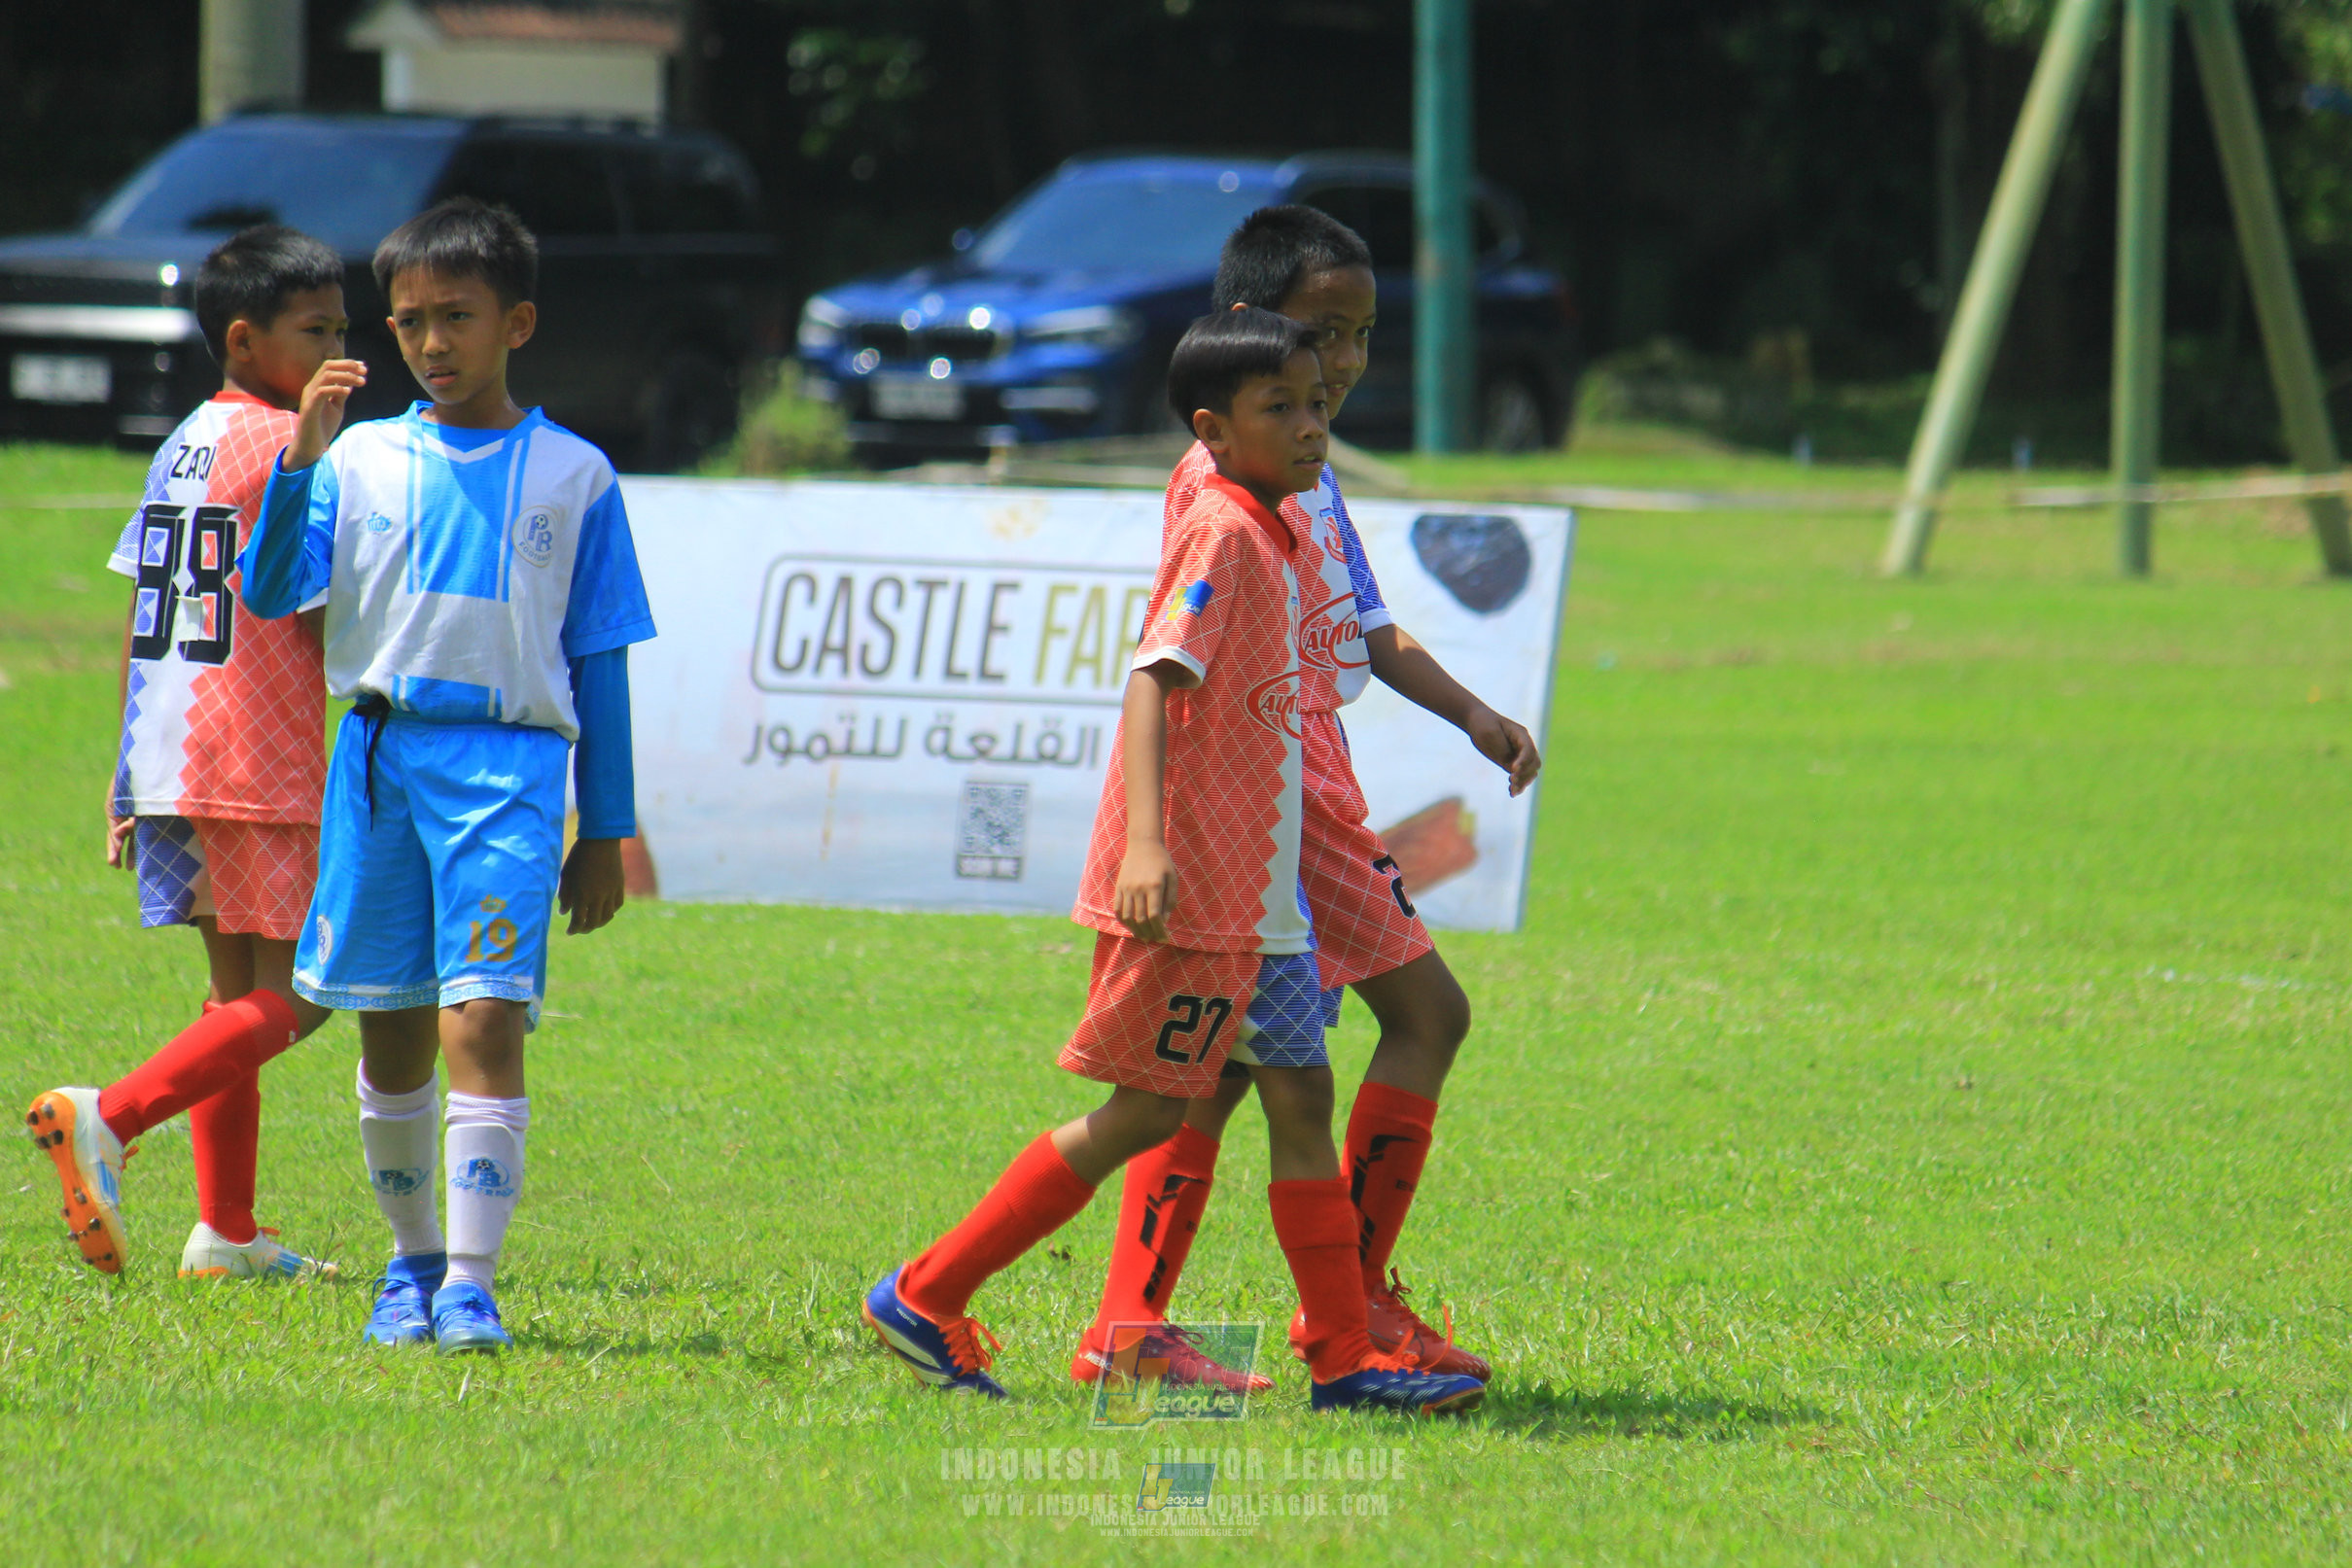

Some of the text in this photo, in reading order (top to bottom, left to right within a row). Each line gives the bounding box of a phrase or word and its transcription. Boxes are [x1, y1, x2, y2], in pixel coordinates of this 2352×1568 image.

[170, 444, 217, 480] ZAQI
[771, 570, 1151, 688] CASTLE FAR
[742, 711, 1102, 770] القلعة للتمور
[465, 918, 518, 963] 19
[1154, 993, 1234, 1065] 27
